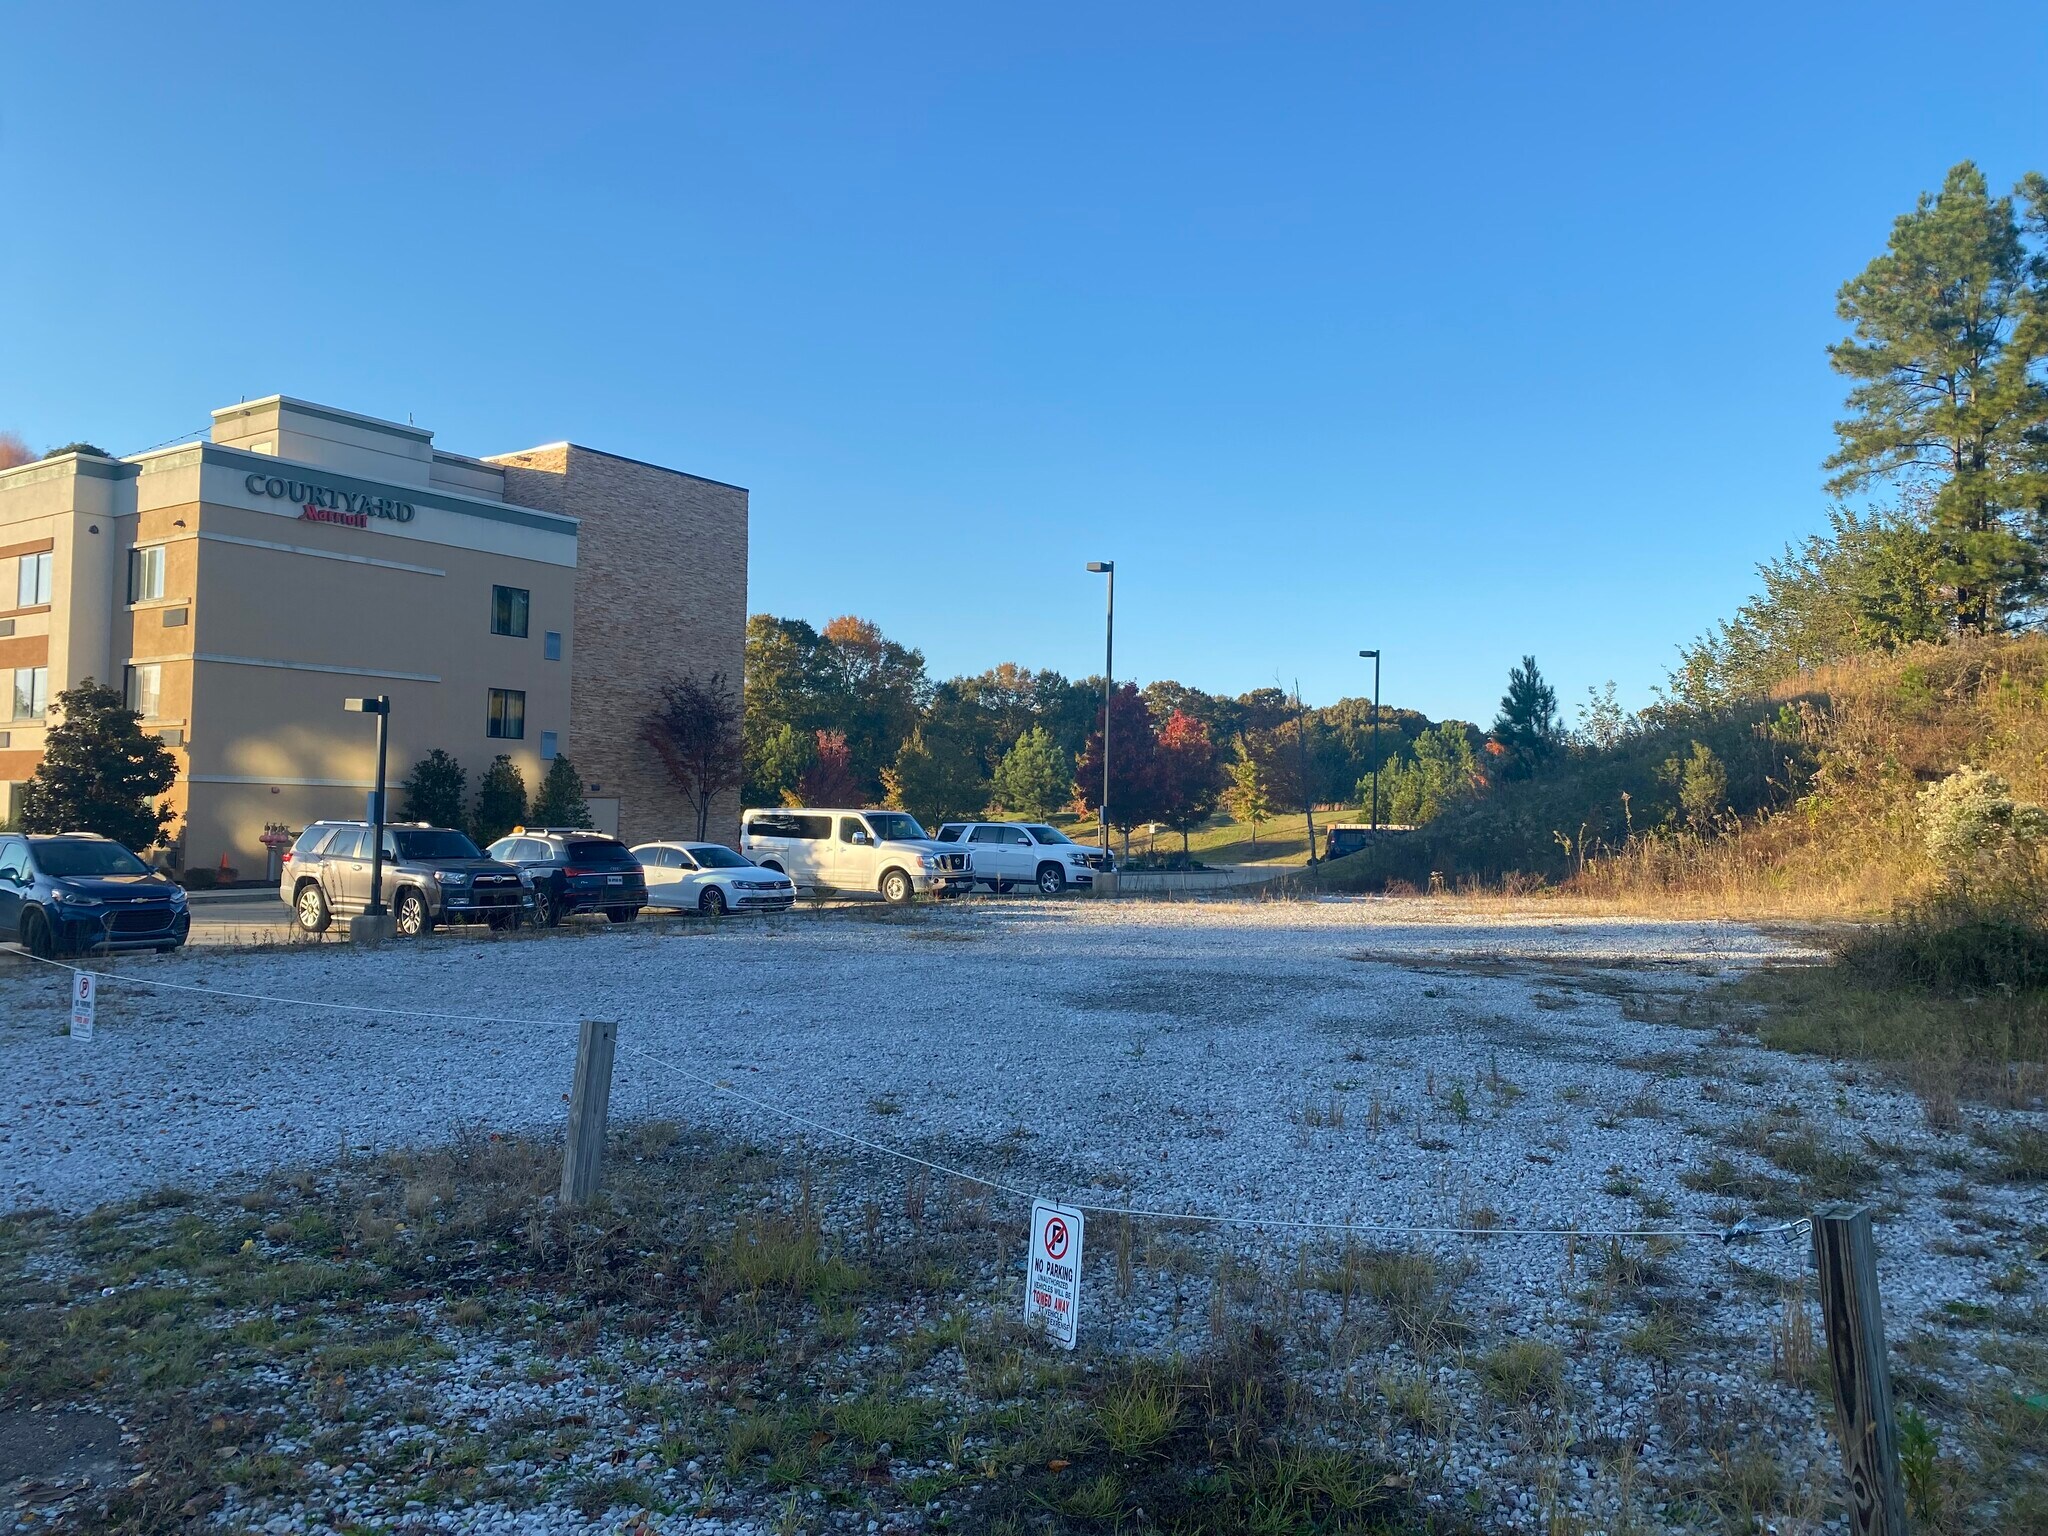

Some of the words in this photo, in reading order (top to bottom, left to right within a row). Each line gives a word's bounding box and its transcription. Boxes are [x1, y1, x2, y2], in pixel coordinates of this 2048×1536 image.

[245, 473, 415, 523] COURTYARD
[298, 504, 368, 528] Marriott
[1035, 1257, 1043, 1273] NO
[1046, 1261, 1072, 1282] PARKING
[1037, 1273, 1068, 1290] UNAUTHORIZED
[1033, 1289, 1052, 1308] TOWED
[1054, 1297, 1070, 1314] AWAY
